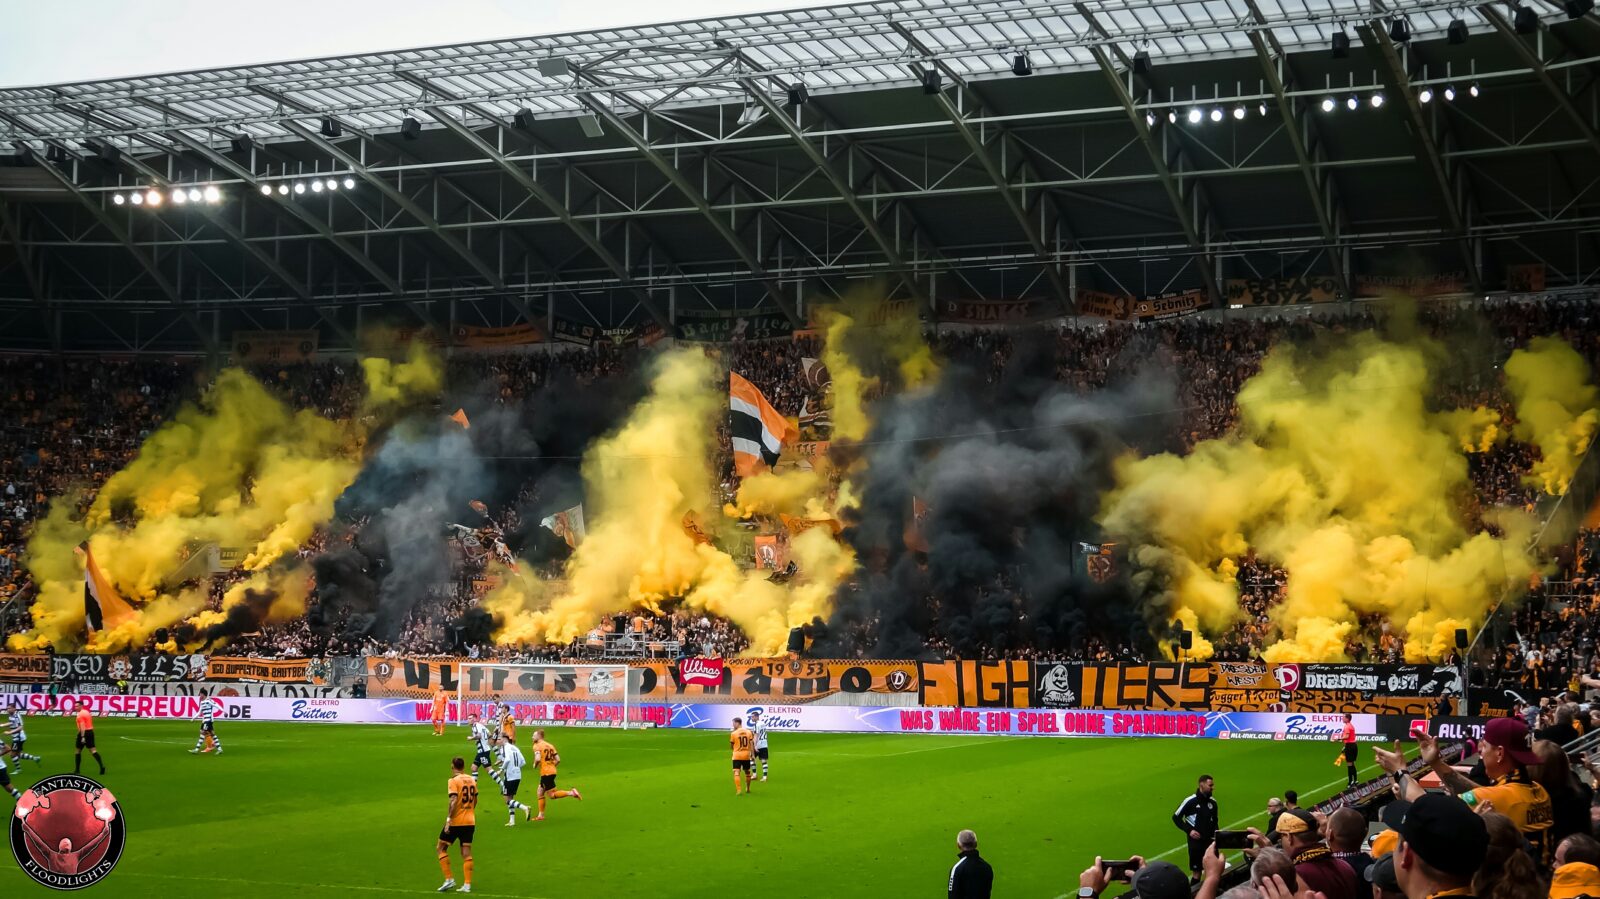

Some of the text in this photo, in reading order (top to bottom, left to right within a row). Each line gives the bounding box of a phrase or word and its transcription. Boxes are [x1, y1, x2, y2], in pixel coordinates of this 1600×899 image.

[1153, 297, 1195, 311] Sebnitz
[683, 659, 721, 675] Ultras
[767, 663, 784, 676] 19
[806, 663, 824, 676] 53
[291, 699, 339, 719] Büttner
[768, 706, 802, 714] ELEKTRO
[900, 708, 1208, 737] WAS WÄRE EIN SPIEL OHNE SPANNUNG?
[738, 736, 748, 748] 10
[461, 785, 475, 804] 39
